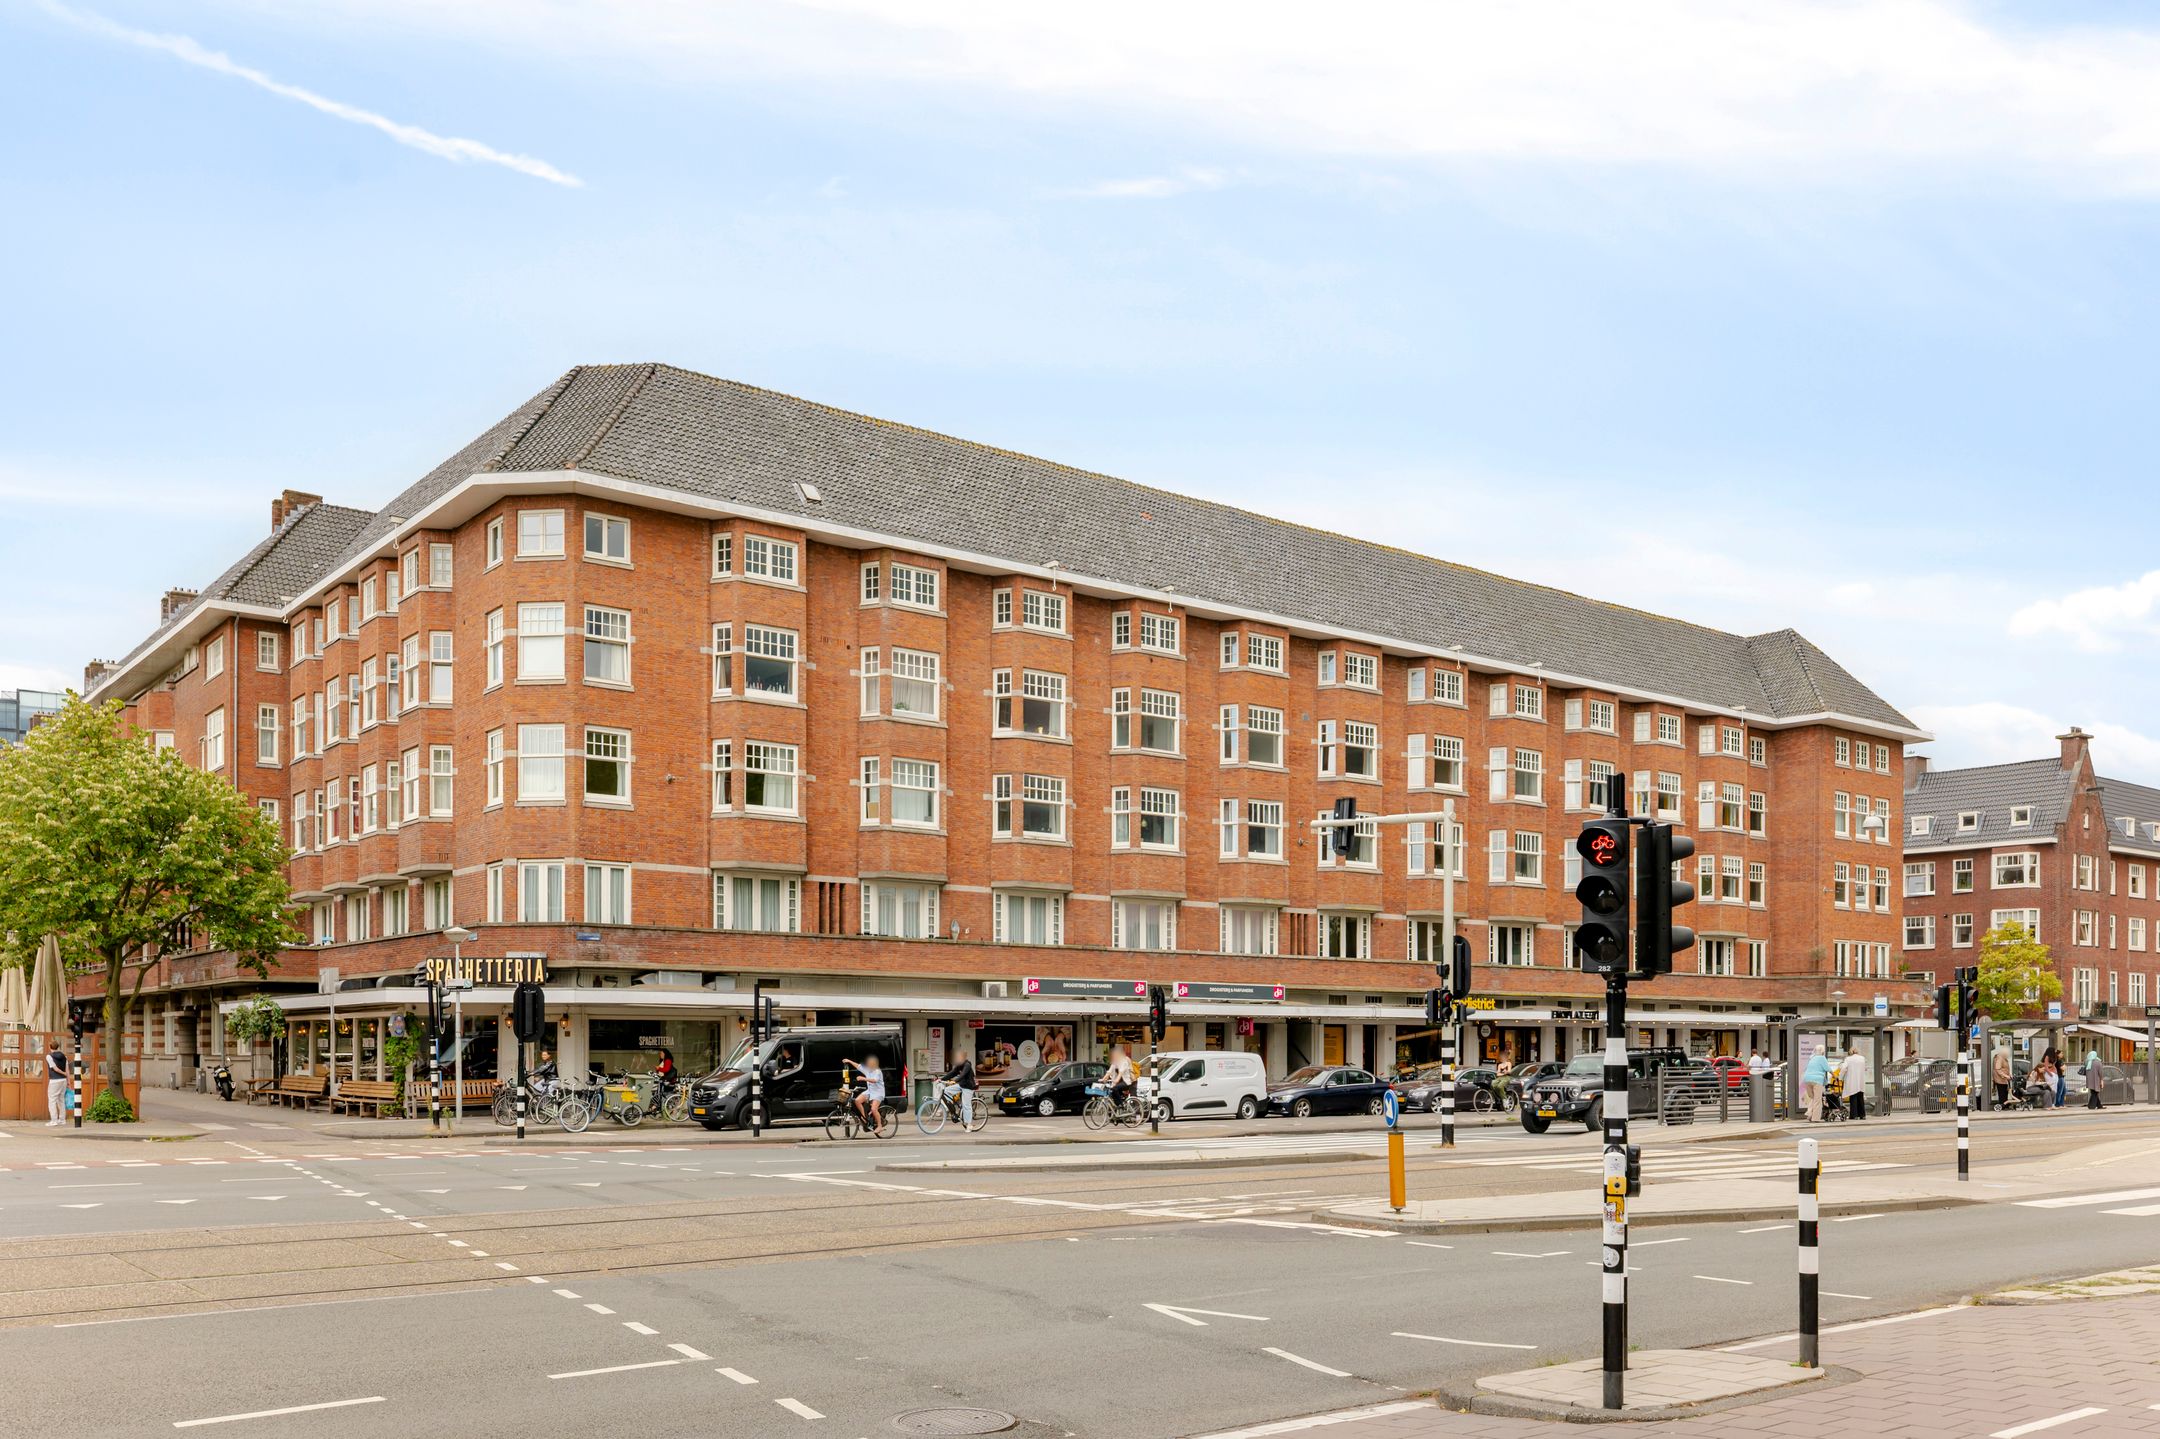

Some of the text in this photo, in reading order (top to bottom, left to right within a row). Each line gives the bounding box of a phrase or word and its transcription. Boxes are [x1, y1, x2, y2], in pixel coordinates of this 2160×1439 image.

[1029, 981, 1039, 991] da
[1135, 983, 1145, 993] da
[1179, 986, 1188, 995] da
[1273, 988, 1283, 998] da
[1239, 1019, 1250, 1033] da
[638, 1036, 675, 1046] SPAGHETTERIA
